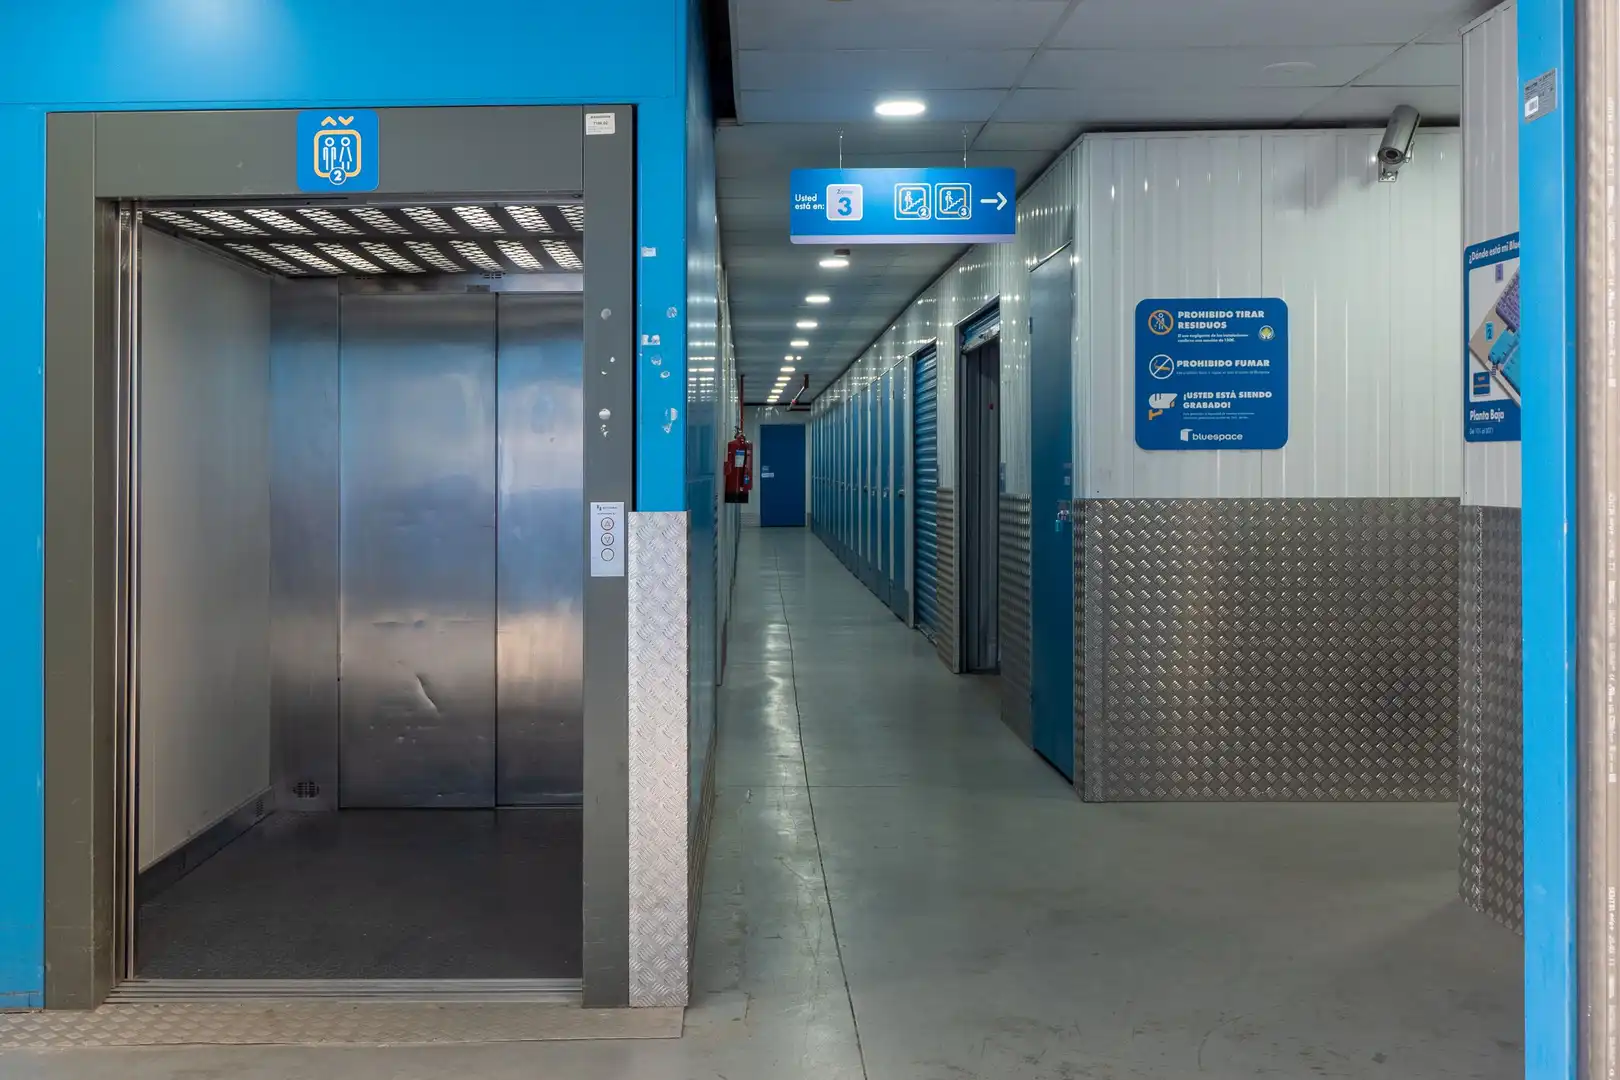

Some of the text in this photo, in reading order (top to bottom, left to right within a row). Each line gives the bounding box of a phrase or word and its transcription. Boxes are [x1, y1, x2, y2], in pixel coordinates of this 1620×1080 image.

[333, 170, 342, 181] 2
[795, 193, 817, 202] Usted
[795, 202, 811, 210] está
[837, 197, 852, 216] 3
[920, 208, 927, 216] 2
[960, 208, 967, 216] 3
[1469, 247, 1489, 264] ¿Dónde
[1489, 243, 1501, 256] está
[1502, 241, 1509, 252] mi
[1178, 310, 1265, 319] PROHIBIDO TIRAR
[1178, 321, 1227, 329] RESIDUOS
[1235, 359, 1270, 367] FUMAR
[1183, 391, 1214, 400] ¡USTED
[1215, 390, 1237, 399] ESTÁ
[1183, 401, 1231, 409] GRABADO!
[1470, 408, 1505, 423] Planta Baja
[1192, 432, 1243, 442] bluespace
